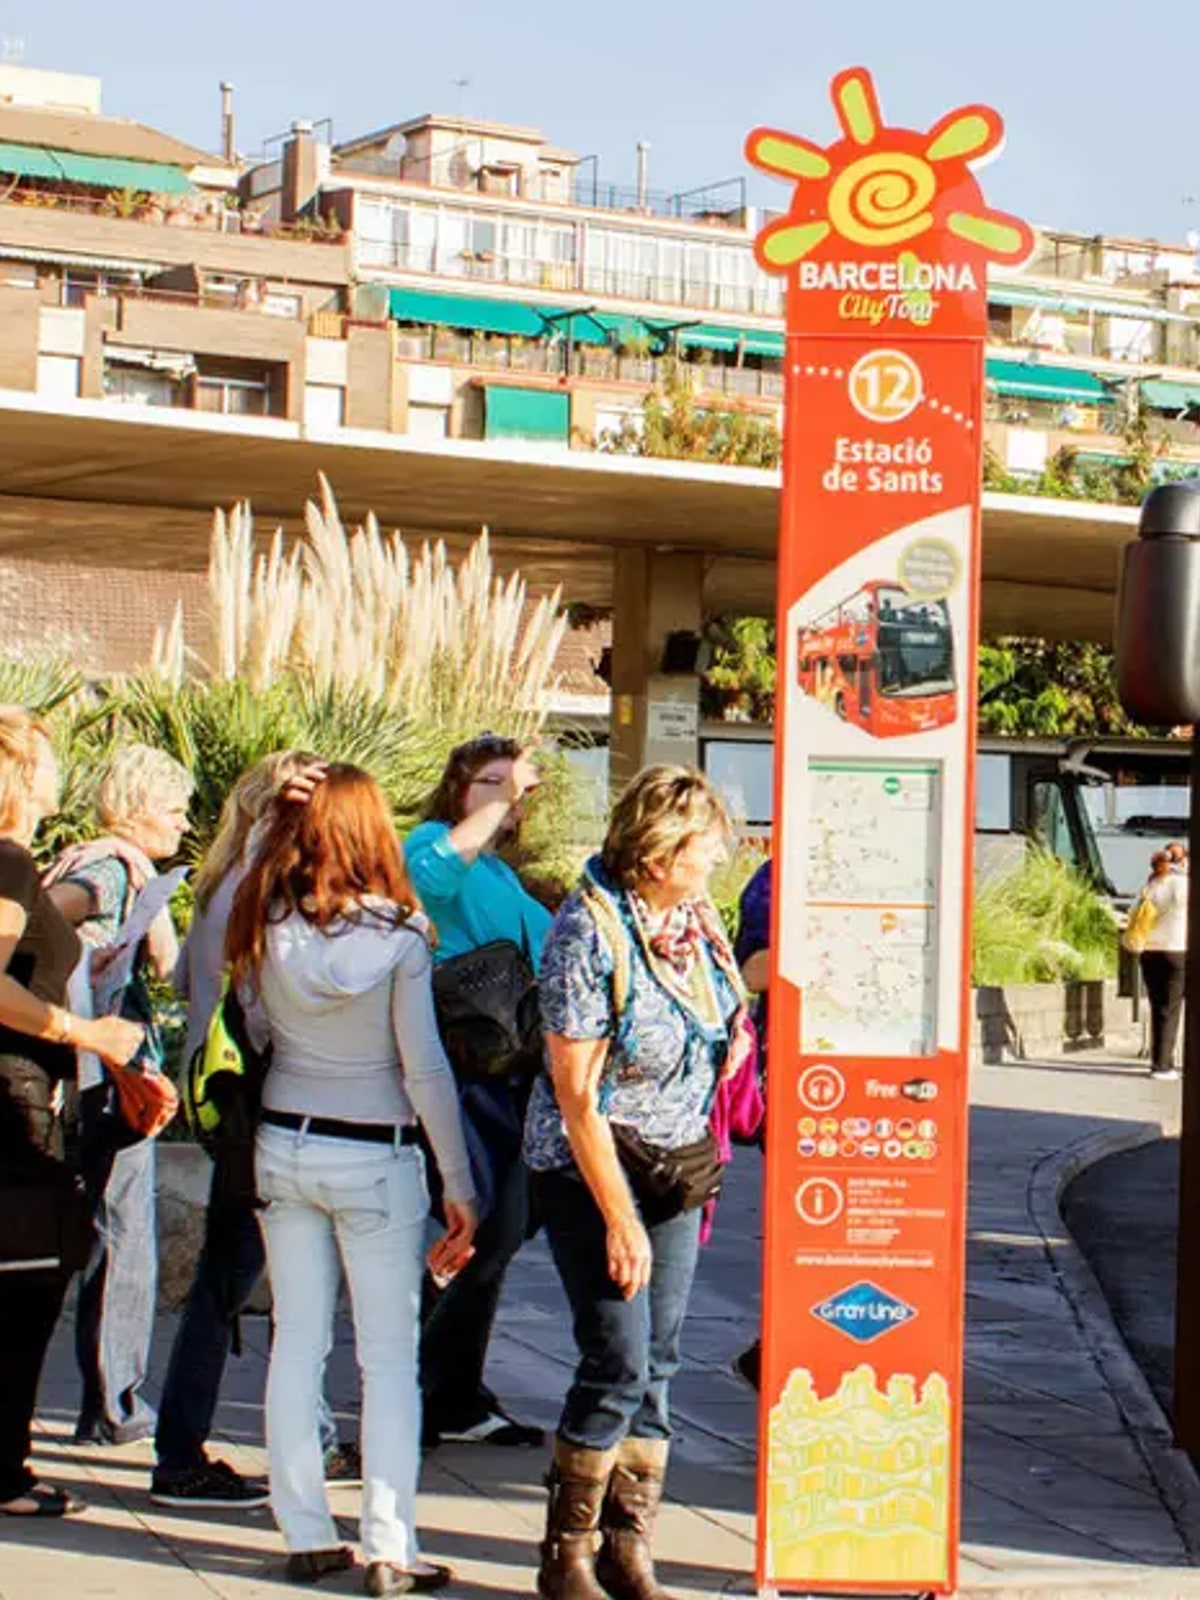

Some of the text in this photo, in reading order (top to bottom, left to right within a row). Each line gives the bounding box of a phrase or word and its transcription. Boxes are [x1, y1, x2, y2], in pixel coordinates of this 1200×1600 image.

[799, 261, 978, 292] BARCELONA
[857, 364, 912, 409] 12
[834, 437, 933, 464] Estació
[822, 463, 944, 493] de Sants
